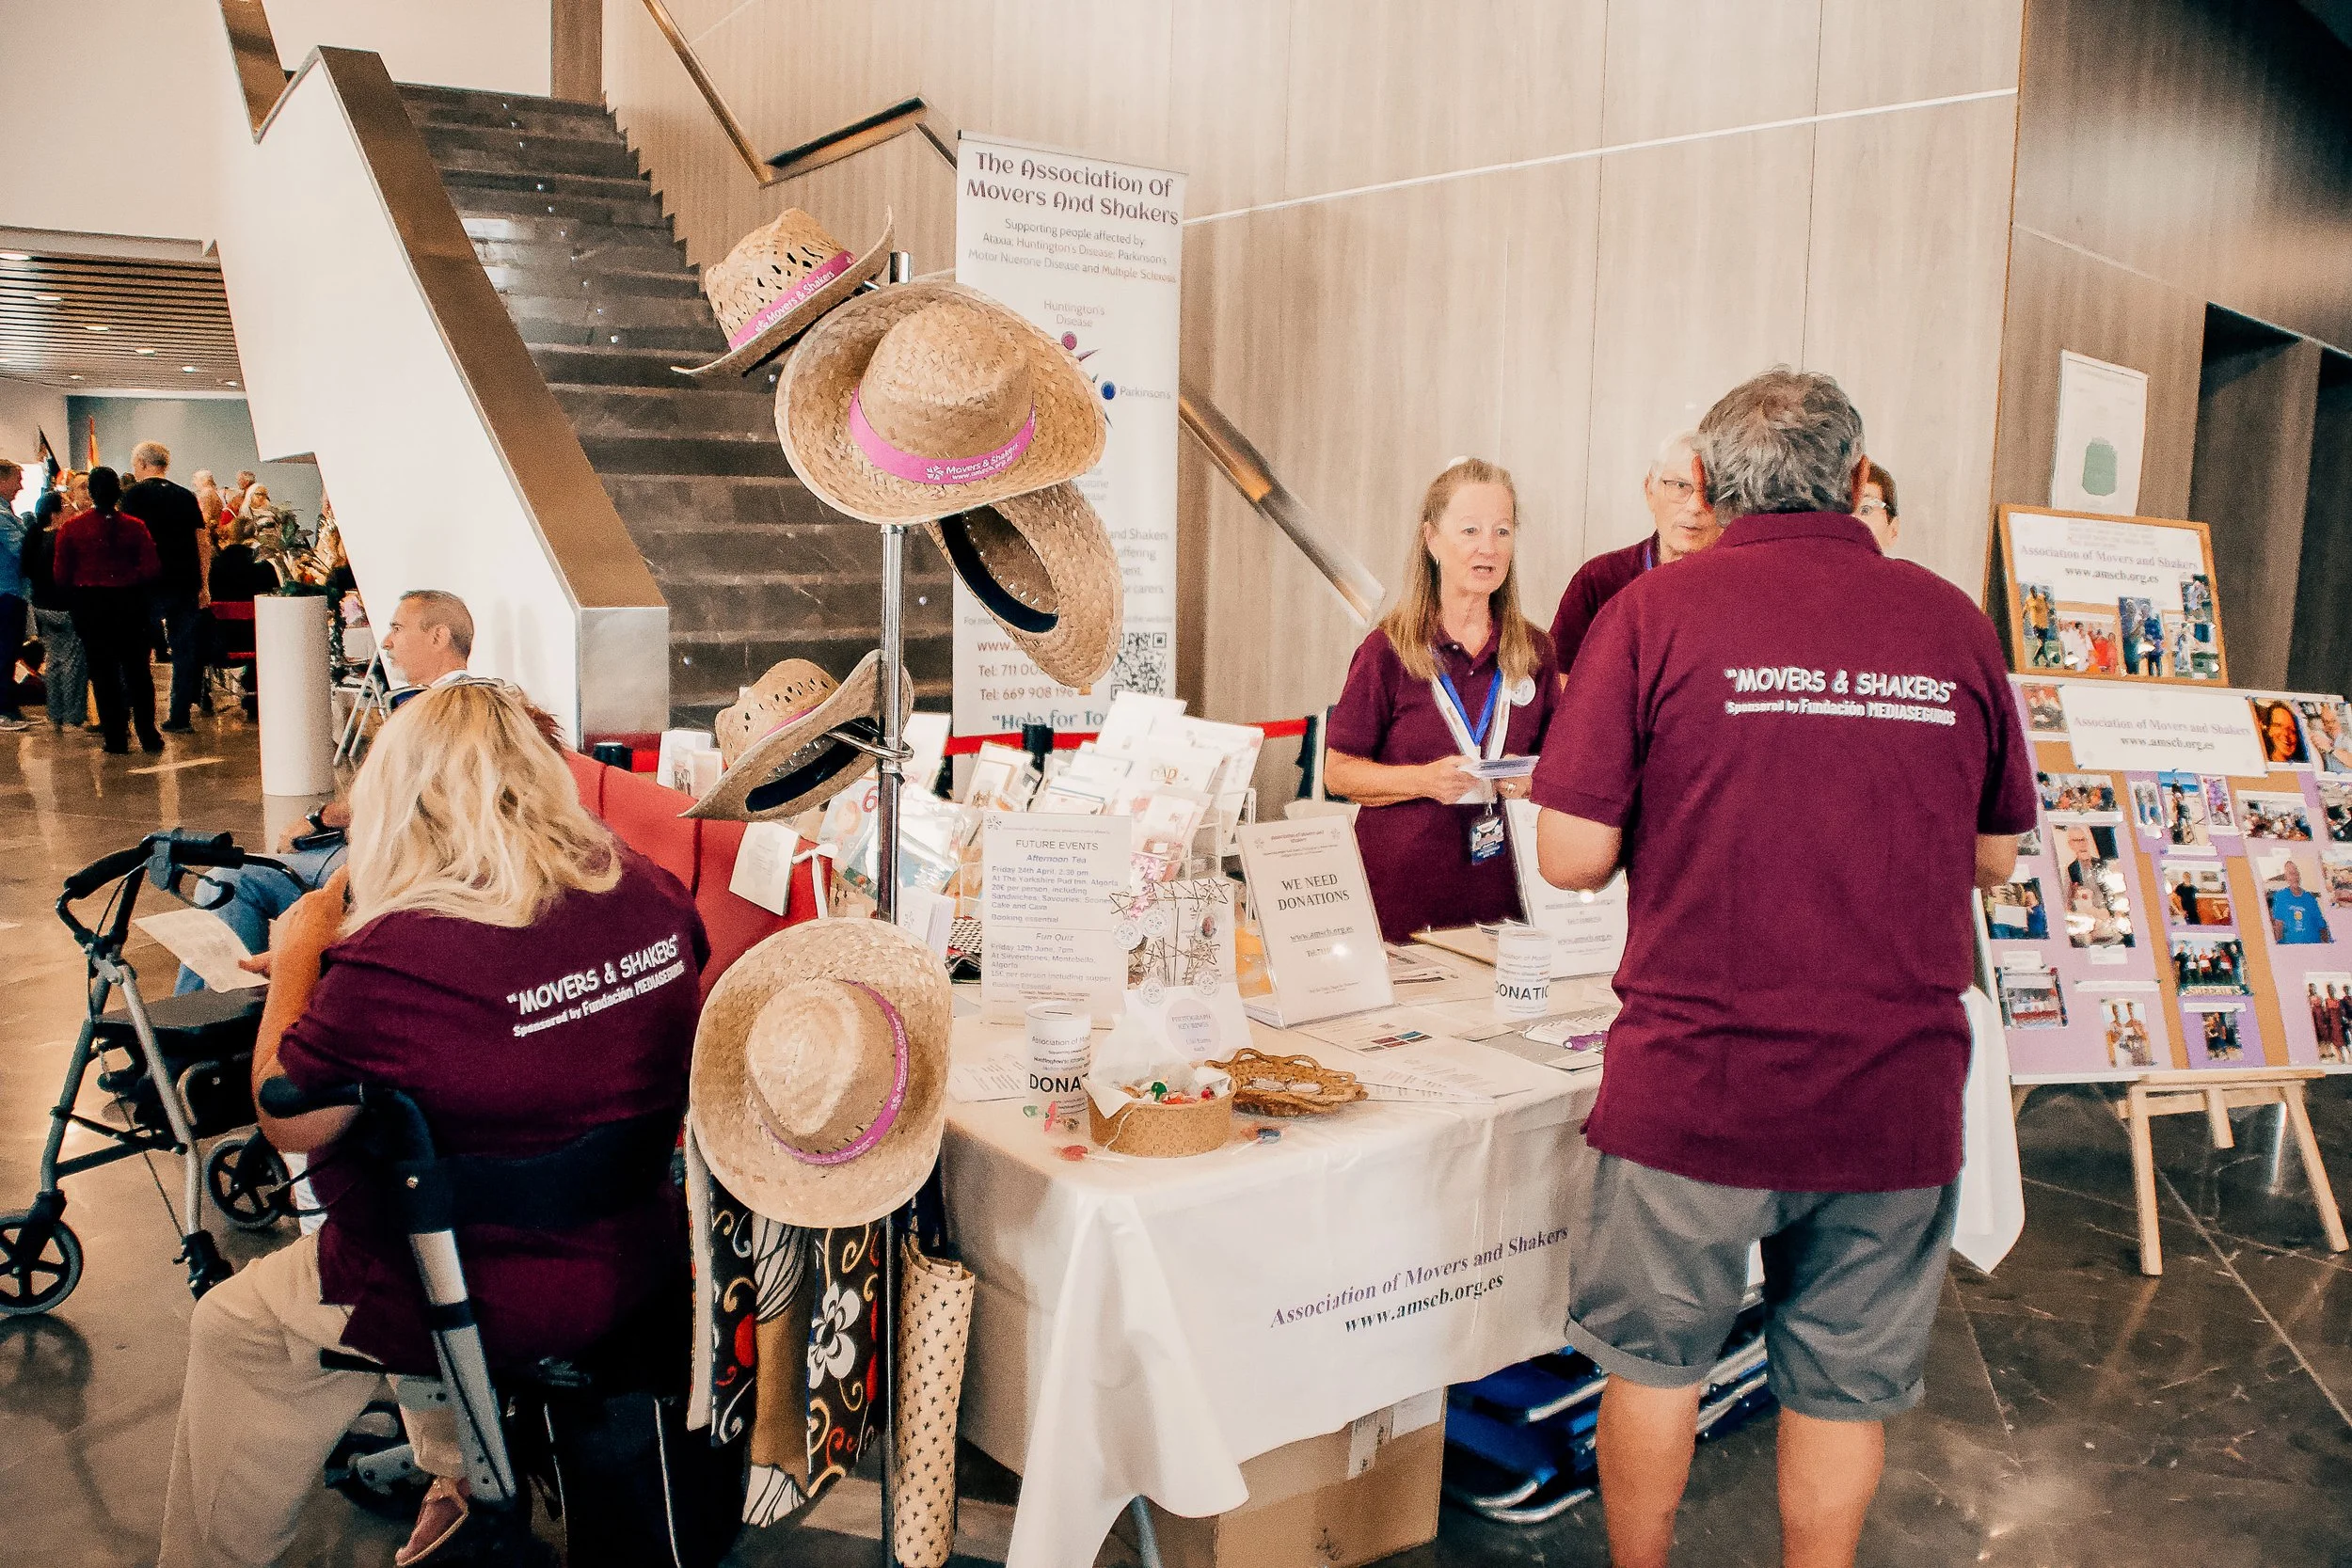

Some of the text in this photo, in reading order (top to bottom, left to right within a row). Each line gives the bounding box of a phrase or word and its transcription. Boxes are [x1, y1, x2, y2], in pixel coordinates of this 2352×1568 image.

[975, 151, 1174, 198] The Association Of
[966, 179, 1179, 226] Movers And Shakers
[1005, 218, 1145, 248] Supporting people affected by
[1016, 237, 1077, 255] Huntington's
[1118, 249, 1168, 265] Parkinson's
[968, 248, 998, 262] Motor
[1000, 252, 1041, 267] Nuerone
[1043, 258, 1080, 271] Disease
[1082, 263, 1100, 274] and
[1102, 266, 1138, 279] Multiple
[766, 270, 835, 323] Movers & Shakers
[1043, 299, 1105, 317] Huntington's
[1056, 314, 1093, 328] Disease
[1119, 385, 1171, 400] Parkinson's
[946, 442, 1019, 475] Movers & Shakers
[2021, 545, 2199, 571] Association of Movers and Shakers
[1001, 663, 1017, 676] 711
[1002, 687, 1025, 701] 669
[1027, 687, 1052, 700] 908
[1724, 666, 1957, 704] "MOVERS & SHAKERS"
[1724, 700, 1786, 716] Sponsored
[1786, 700, 1800, 714] by
[1799, 698, 1867, 718] Fundación
[1049, 709, 1077, 728] for
[2074, 715, 2134, 730] Association
[2137, 717, 2148, 731] of
[2149, 719, 2188, 735] Movers
[2189, 721, 2209, 735] and
[1016, 839, 1099, 851] FUTURE EVENTS
[1026, 854, 1087, 864] Afternoon Tea
[992, 865, 1015, 874] Friday
[1007, 884, 1020, 893] per
[1052, 886, 1088, 895] including
[1018, 876, 1055, 885] Yorkshire
[1280, 873, 1339, 892] WE NEED
[991, 901, 1010, 910] Cake
[1278, 890, 1351, 911] DONATIONS
[991, 913, 1059, 924] Booking essential
[1035, 932, 1074, 942] Fun Quiz
[991, 942, 1014, 952] Friday
[991, 951, 1000, 959] At
[505, 934, 678, 1016] "MOVERS & SHAKERS"
[1006, 971, 1019, 979] per
[1020, 971, 1046, 980] person
[1048, 972, 1084, 982] including
[1085, 974, 1112, 983] supper
[512, 1010, 569, 1038] Sponsored
[568, 1006, 582, 1021] by
[1031, 1036, 1070, 1047] Association
[1270, 1226, 1570, 1329] Association of Movers and Shakers
[1343, 1274, 1505, 1334] www.amscb.org.es
